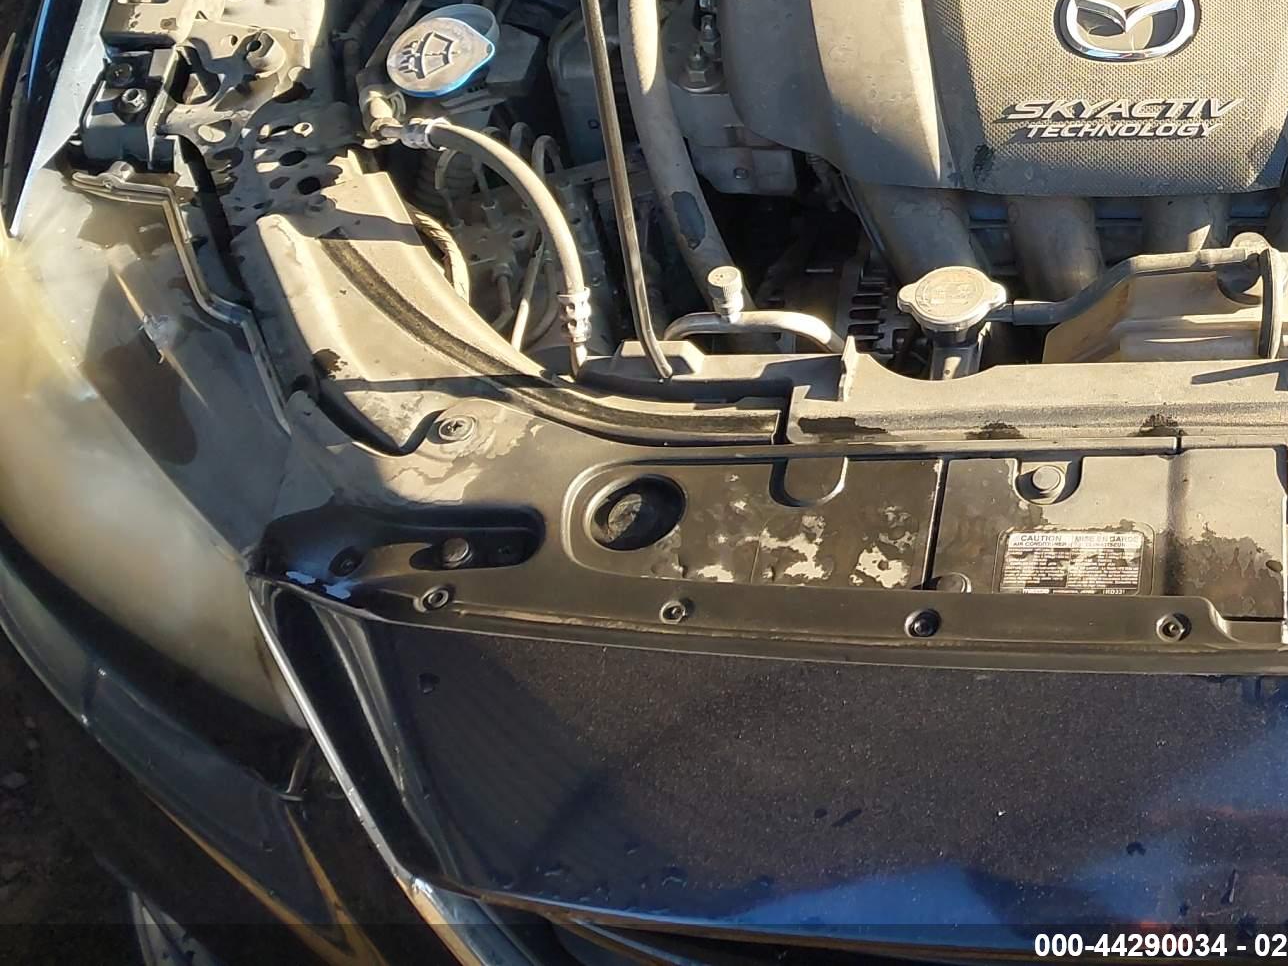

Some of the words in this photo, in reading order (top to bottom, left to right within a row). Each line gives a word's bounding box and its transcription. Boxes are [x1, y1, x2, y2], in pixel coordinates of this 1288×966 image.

[1006, 97, 1246, 120] SKYACTIV
[1025, 122, 1224, 139] TECHNOLOGY
[1020, 534, 1062, 542] CAUTION
